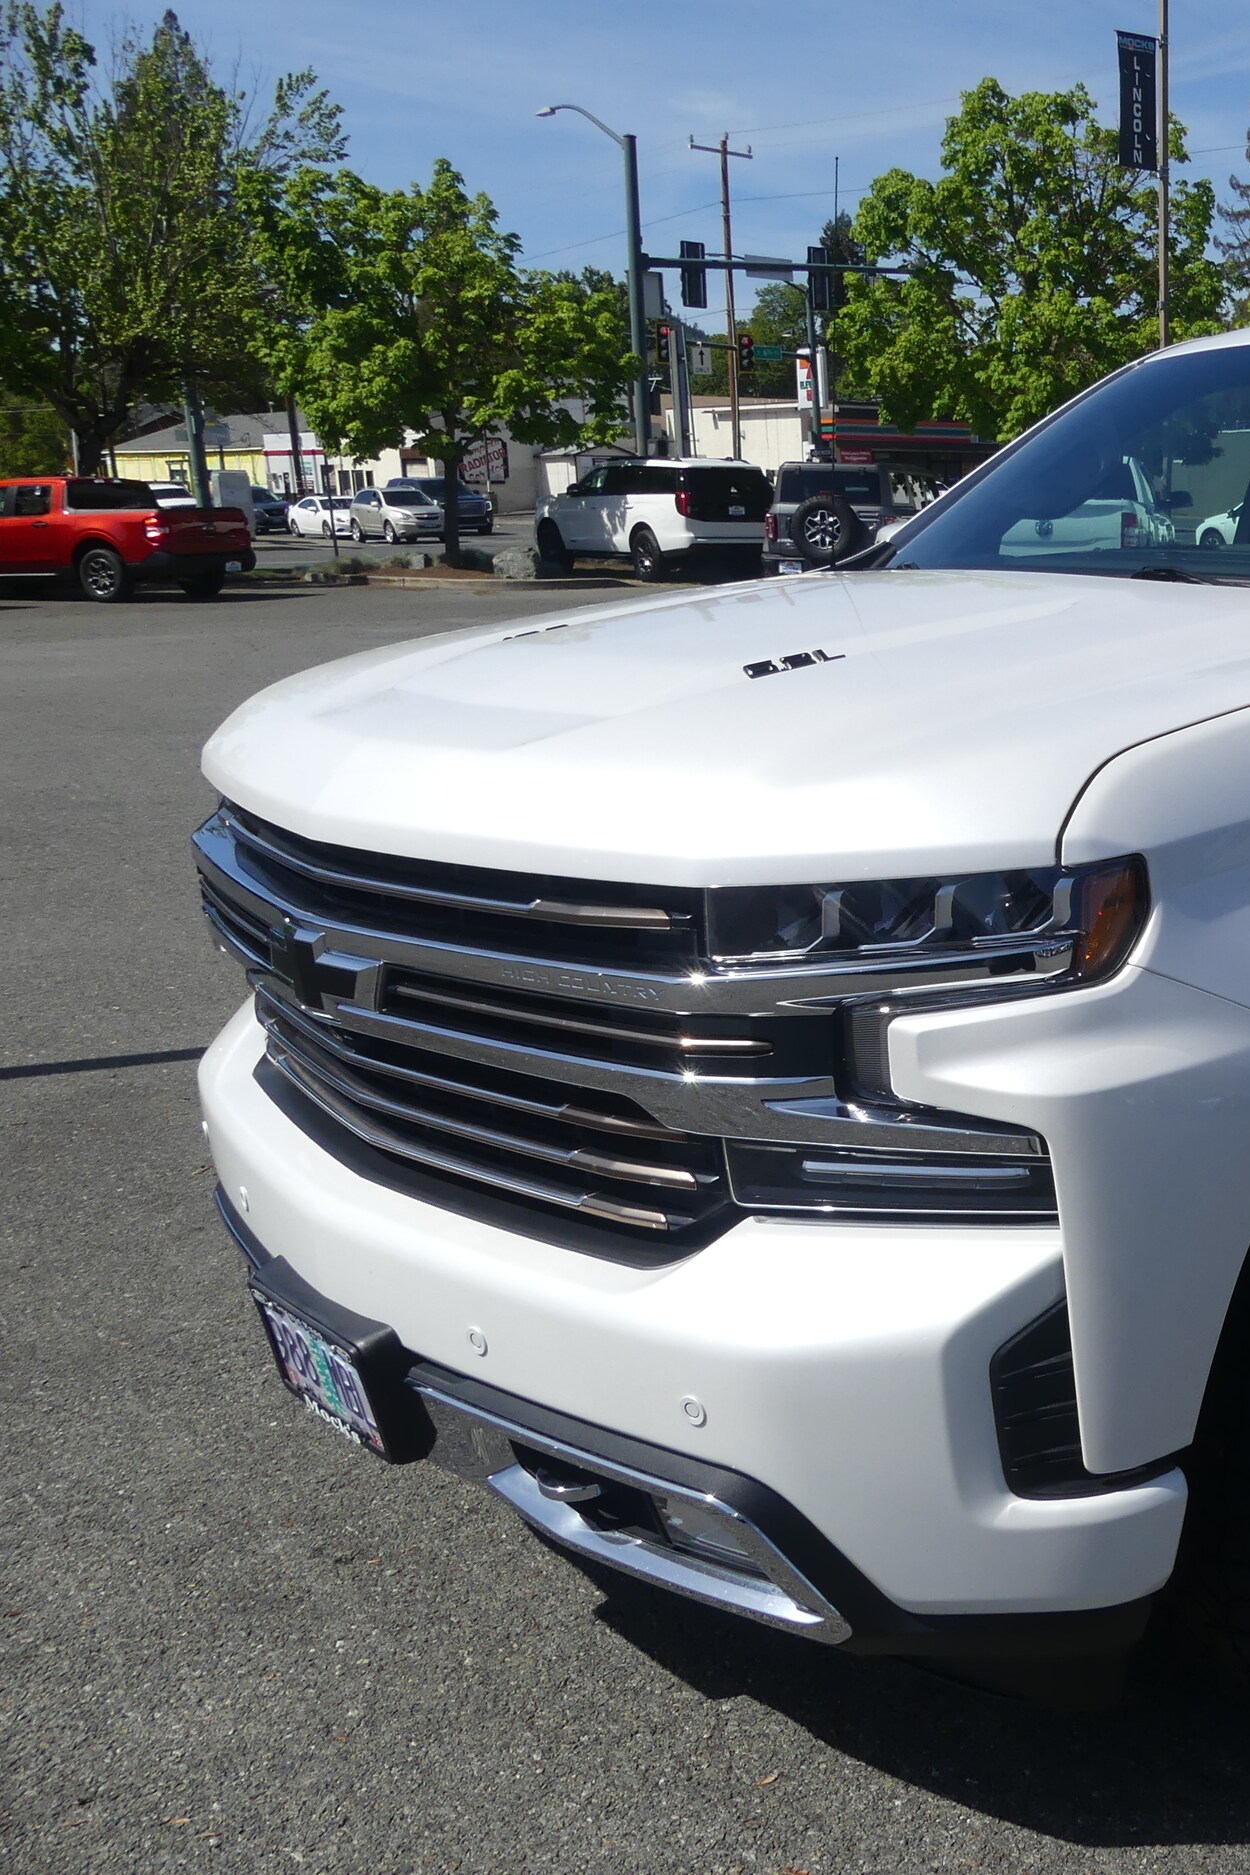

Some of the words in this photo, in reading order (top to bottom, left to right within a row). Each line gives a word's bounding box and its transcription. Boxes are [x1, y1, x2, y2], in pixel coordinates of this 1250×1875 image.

[1133, 56, 1142, 164] LINCOLN
[458, 447, 506, 473] RADIATOR
[502, 968, 550, 984] HIGH
[558, 975, 665, 1001] COUNTRY
